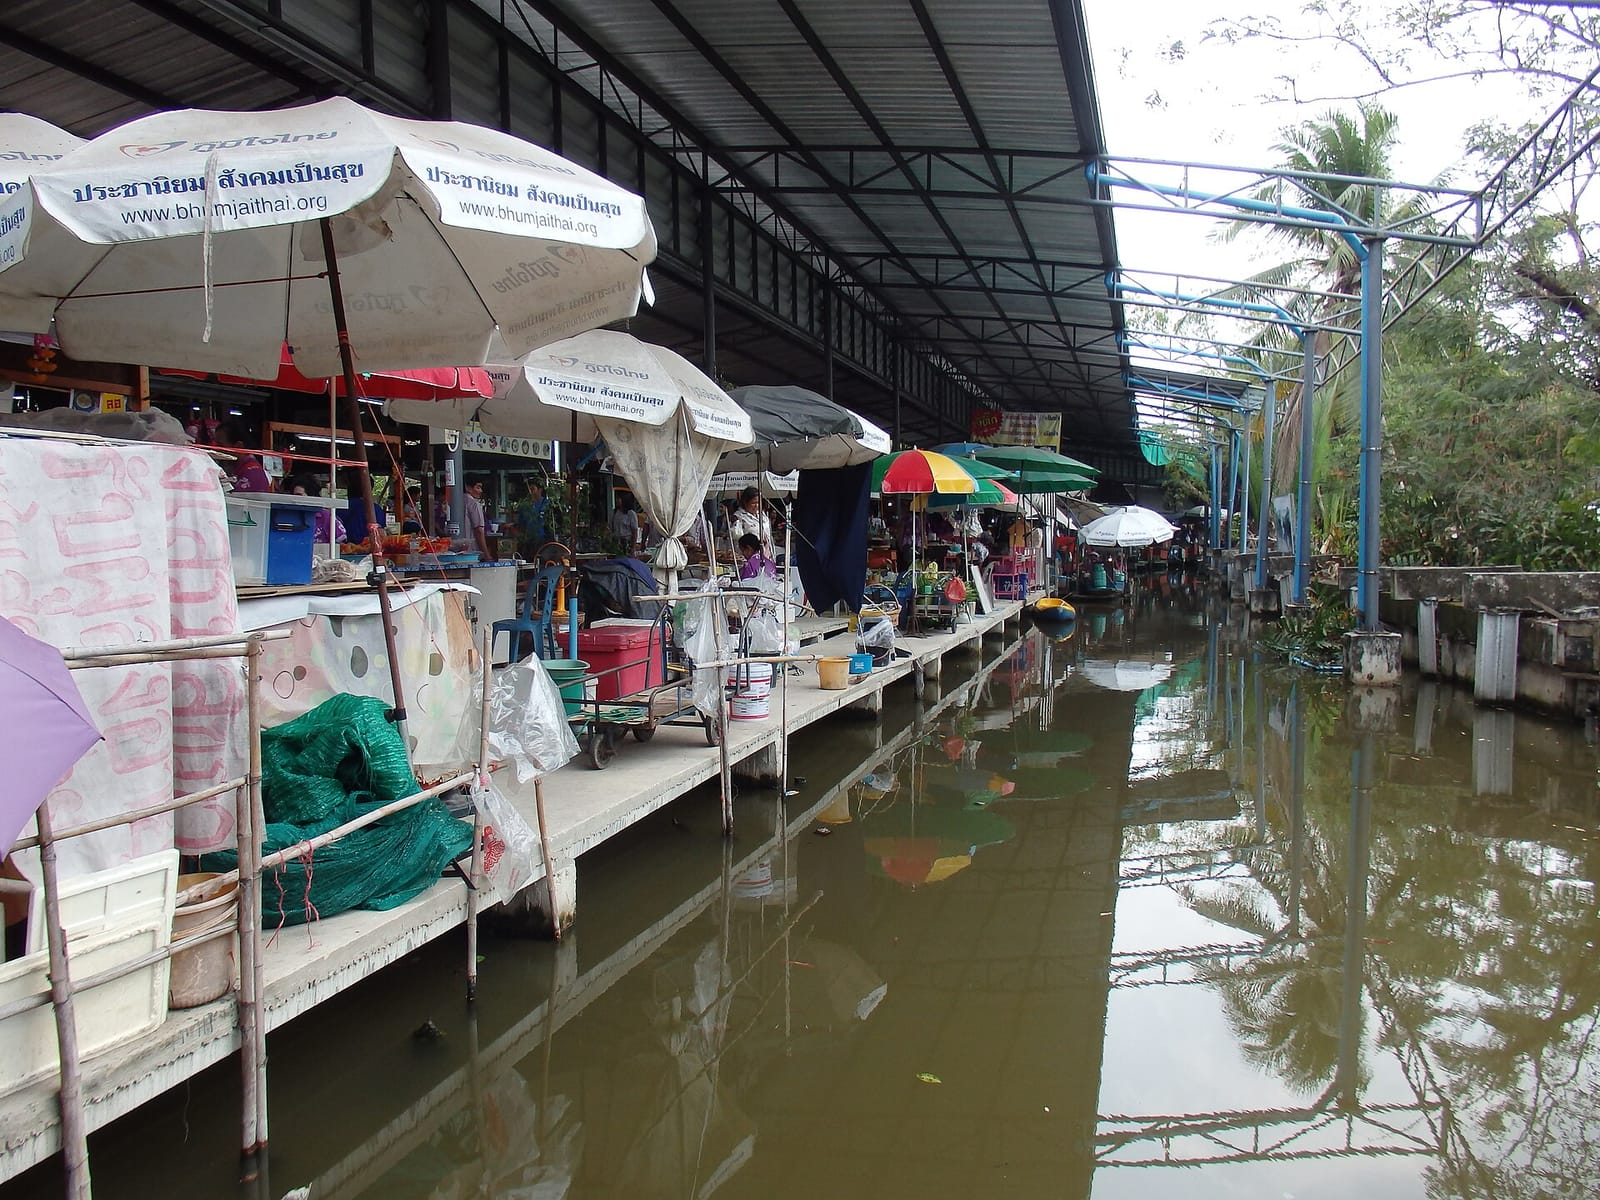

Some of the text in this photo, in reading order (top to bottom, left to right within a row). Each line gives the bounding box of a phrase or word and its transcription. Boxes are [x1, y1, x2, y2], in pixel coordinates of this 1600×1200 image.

[73, 162, 364, 203] ประชานิยม สังคมเป็นสุข
[426, 166, 622, 218] ประชานิยม สังคมเป็นสุข
[121, 195, 328, 225] www.bhumjaithai.org
[459, 200, 598, 238] www.bhumjaithai.org
[538, 376, 664, 407] ประชานิยม สังคมเป็นสุข
[555, 393, 646, 417] www.bhumjaithai.org
